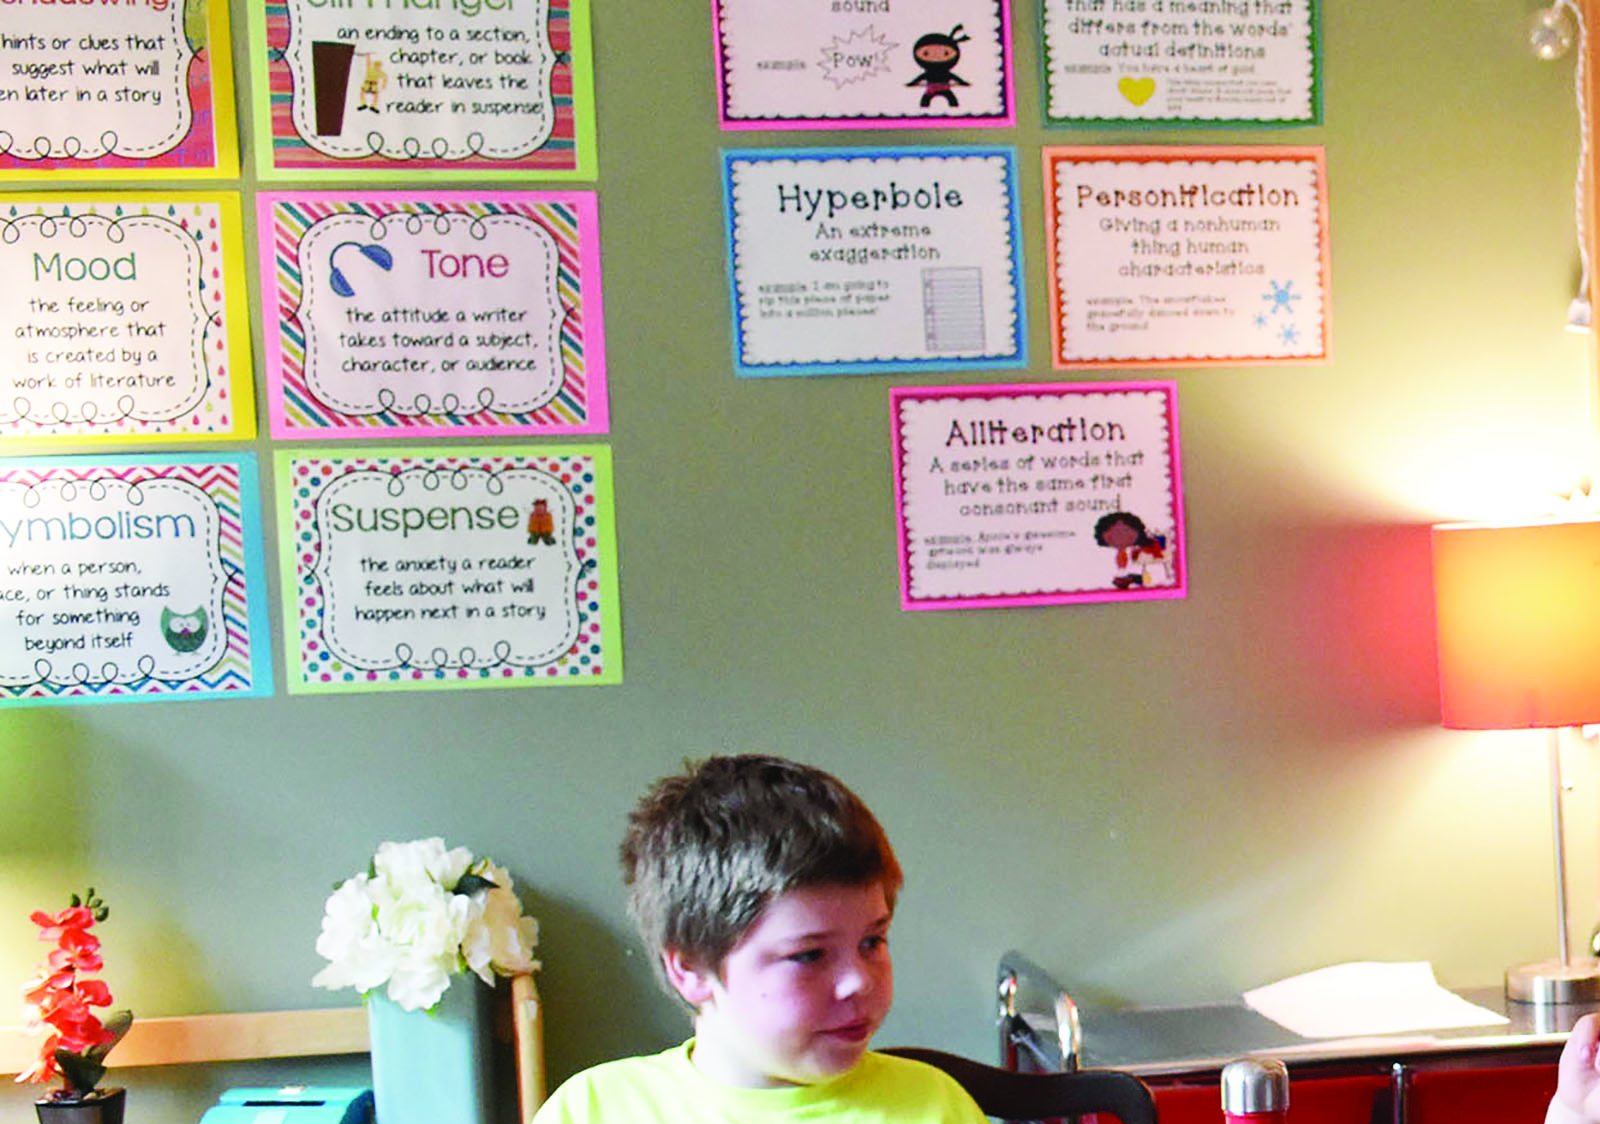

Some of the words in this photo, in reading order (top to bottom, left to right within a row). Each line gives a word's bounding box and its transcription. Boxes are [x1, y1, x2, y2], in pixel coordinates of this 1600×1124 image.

[337, 28, 359, 39] an
[365, 25, 419, 44] ending
[426, 26, 444, 41] to
[449, 29, 460, 40] a
[1069, 17, 1135, 34] differs
[1141, 20, 1188, 35] from
[1193, 20, 1224, 36] the
[1, 33, 46, 50] hints
[51, 38, 71, 50] or
[79, 34, 119, 50] clues
[124, 35, 165, 50] that
[1099, 41, 1159, 57] actual
[1165, 40, 1265, 59] definitions
[469, 53, 488, 64] or
[495, 50, 532, 65] book
[12, 60, 74, 79] suggest
[83, 60, 128, 75] what
[135, 60, 159, 75] will
[396, 73, 434, 88] that
[442, 75, 493, 89] leaves
[499, 75, 528, 90] the
[25, 86, 68, 101] later
[76, 88, 91, 101] in
[97, 90, 107, 101] a
[115, 86, 161, 105] story
[386, 99, 443, 113] reader
[451, 102, 466, 113] in
[778, 182, 963, 221] Hyperbole
[1077, 184, 1299, 208] Personification
[815, 222, 842, 239] An
[849, 222, 931, 238] extreme
[1100, 217, 1161, 236] Giving
[1168, 220, 1178, 232] a
[1184, 216, 1280, 232] nonhuman
[810, 244, 940, 265] exaggeration
[1131, 239, 1181, 258] thing
[1186, 238, 1248, 254] human
[33, 252, 136, 281] Mood
[421, 249, 509, 278] Tone
[1118, 260, 1264, 277] characteristics
[29, 298, 59, 312] the
[67, 297, 124, 316] feeling
[130, 301, 149, 312] or
[346, 308, 375, 322] the
[382, 308, 450, 323] attitude
[456, 311, 466, 322] a
[473, 308, 527, 322] writer
[15, 323, 119, 339] atmosphere
[127, 322, 165, 336] that
[340, 332, 386, 348] takes
[392, 333, 454, 348] toward
[459, 335, 469, 347] a
[27, 352, 39, 363] is
[46, 348, 115, 363] created
[121, 349, 141, 366] by
[148, 350, 157, 361] a
[441, 360, 459, 372] or
[466, 357, 536, 371] audience
[13, 374, 56, 389] work
[64, 372, 82, 388] of
[90, 373, 176, 387] literature
[946, 417, 1125, 447] Alliteration
[929, 457, 944, 474] A
[950, 456, 1010, 472] series
[1016, 455, 1035, 470] of
[1040, 451, 1100, 469] words
[1105, 451, 1144, 466] that
[944, 480, 993, 496] have
[996, 477, 1029, 493] the
[1036, 478, 1085, 491] same
[1091, 473, 1132, 489] first
[959, 498, 1059, 516] consonant
[1066, 493, 1122, 514] sound
[0, 511, 195, 548] ymbolism
[329, 504, 519, 539] Suspense
[8, 563, 55, 575] when
[61, 564, 71, 575] a
[360, 557, 388, 572] the
[395, 556, 457, 574] anxiety
[462, 559, 472, 570] a
[479, 556, 536, 570] reader
[37, 589, 55, 600] or
[64, 585, 108, 602] thing
[115, 584, 170, 598] stands
[365, 581, 403, 596] feels
[409, 580, 454, 596] about
[462, 579, 503, 594] what
[511, 578, 534, 593] will
[16, 610, 44, 626] for
[53, 609, 140, 626] something
[355, 606, 415, 622] happen
[421, 605, 458, 619] next
[466, 607, 480, 618] in
[485, 606, 495, 618] a
[502, 603, 546, 621] story
[24, 635, 85, 654] beyond
[92, 632, 133, 648] itself
